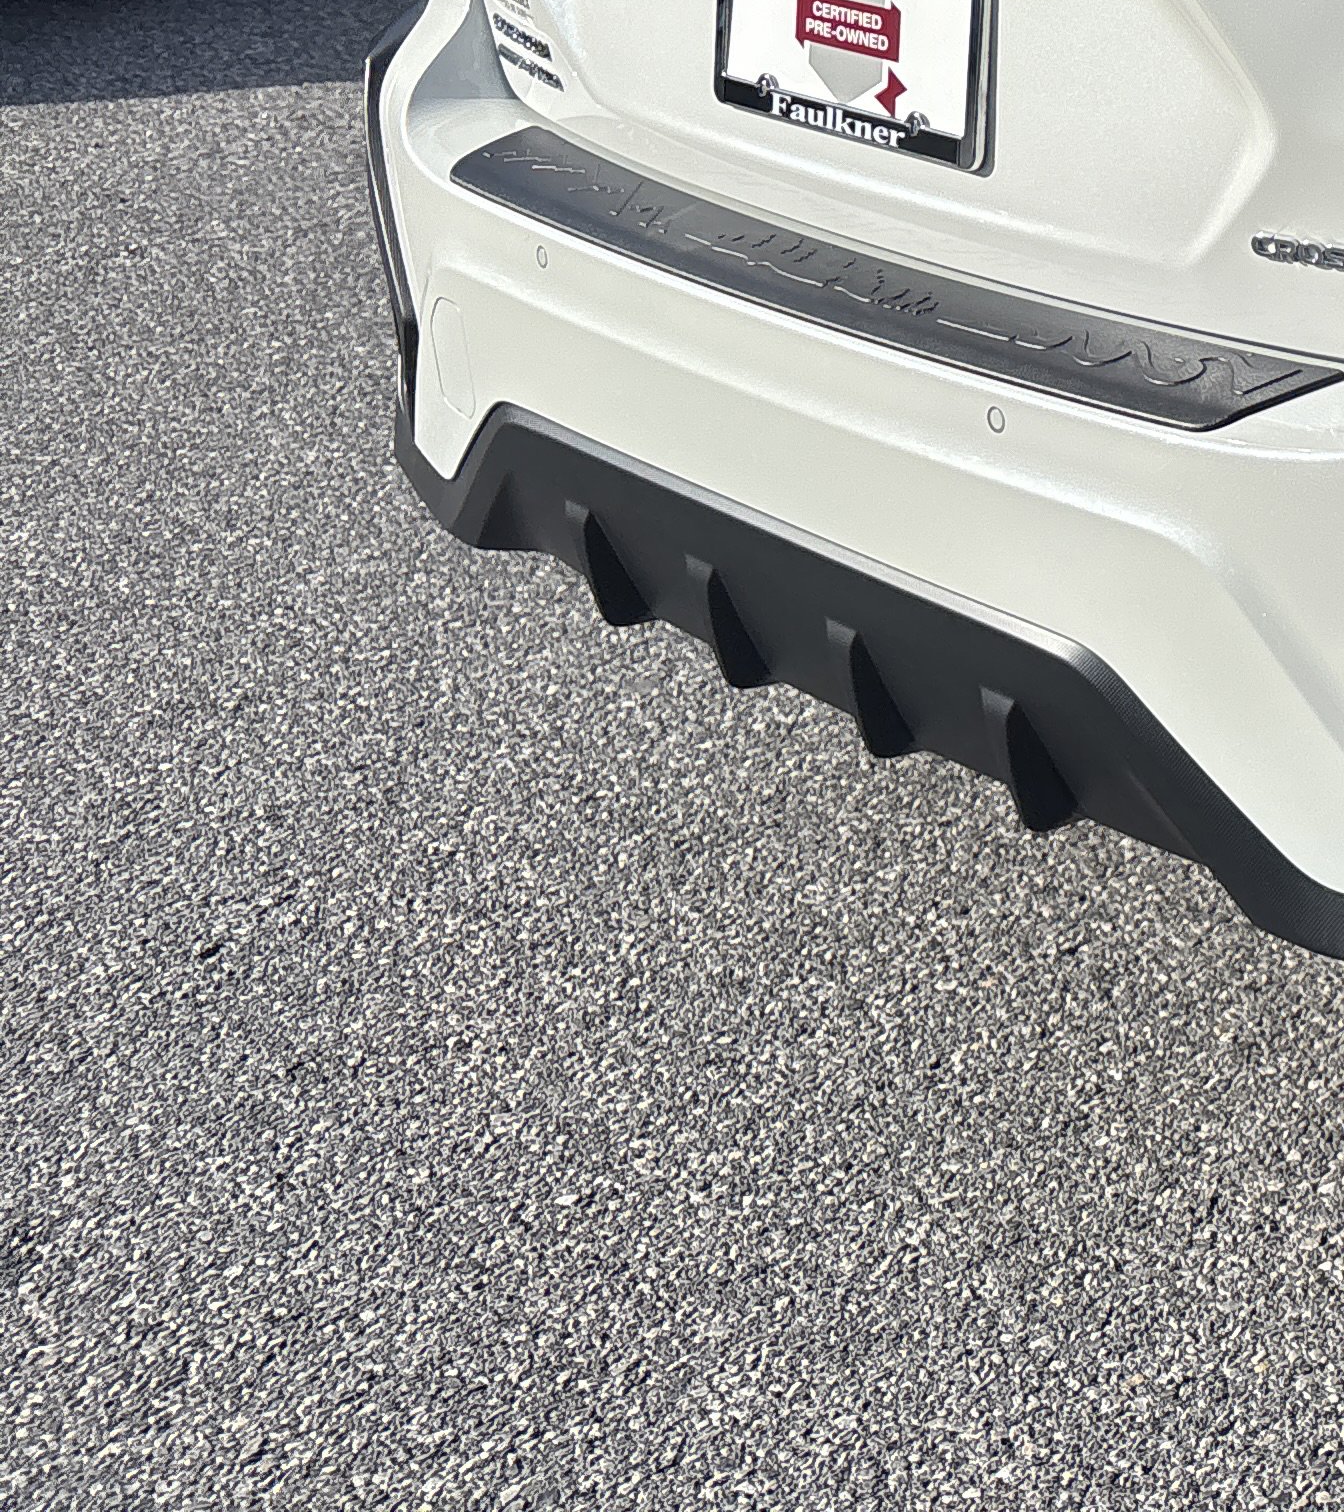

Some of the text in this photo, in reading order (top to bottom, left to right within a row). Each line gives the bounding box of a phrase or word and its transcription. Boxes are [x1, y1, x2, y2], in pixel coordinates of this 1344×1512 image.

[812, 0, 883, 30] CERTIFIED
[805, 17, 889, 51] PRE-OWNED
[768, 91, 906, 148] Faulkner
